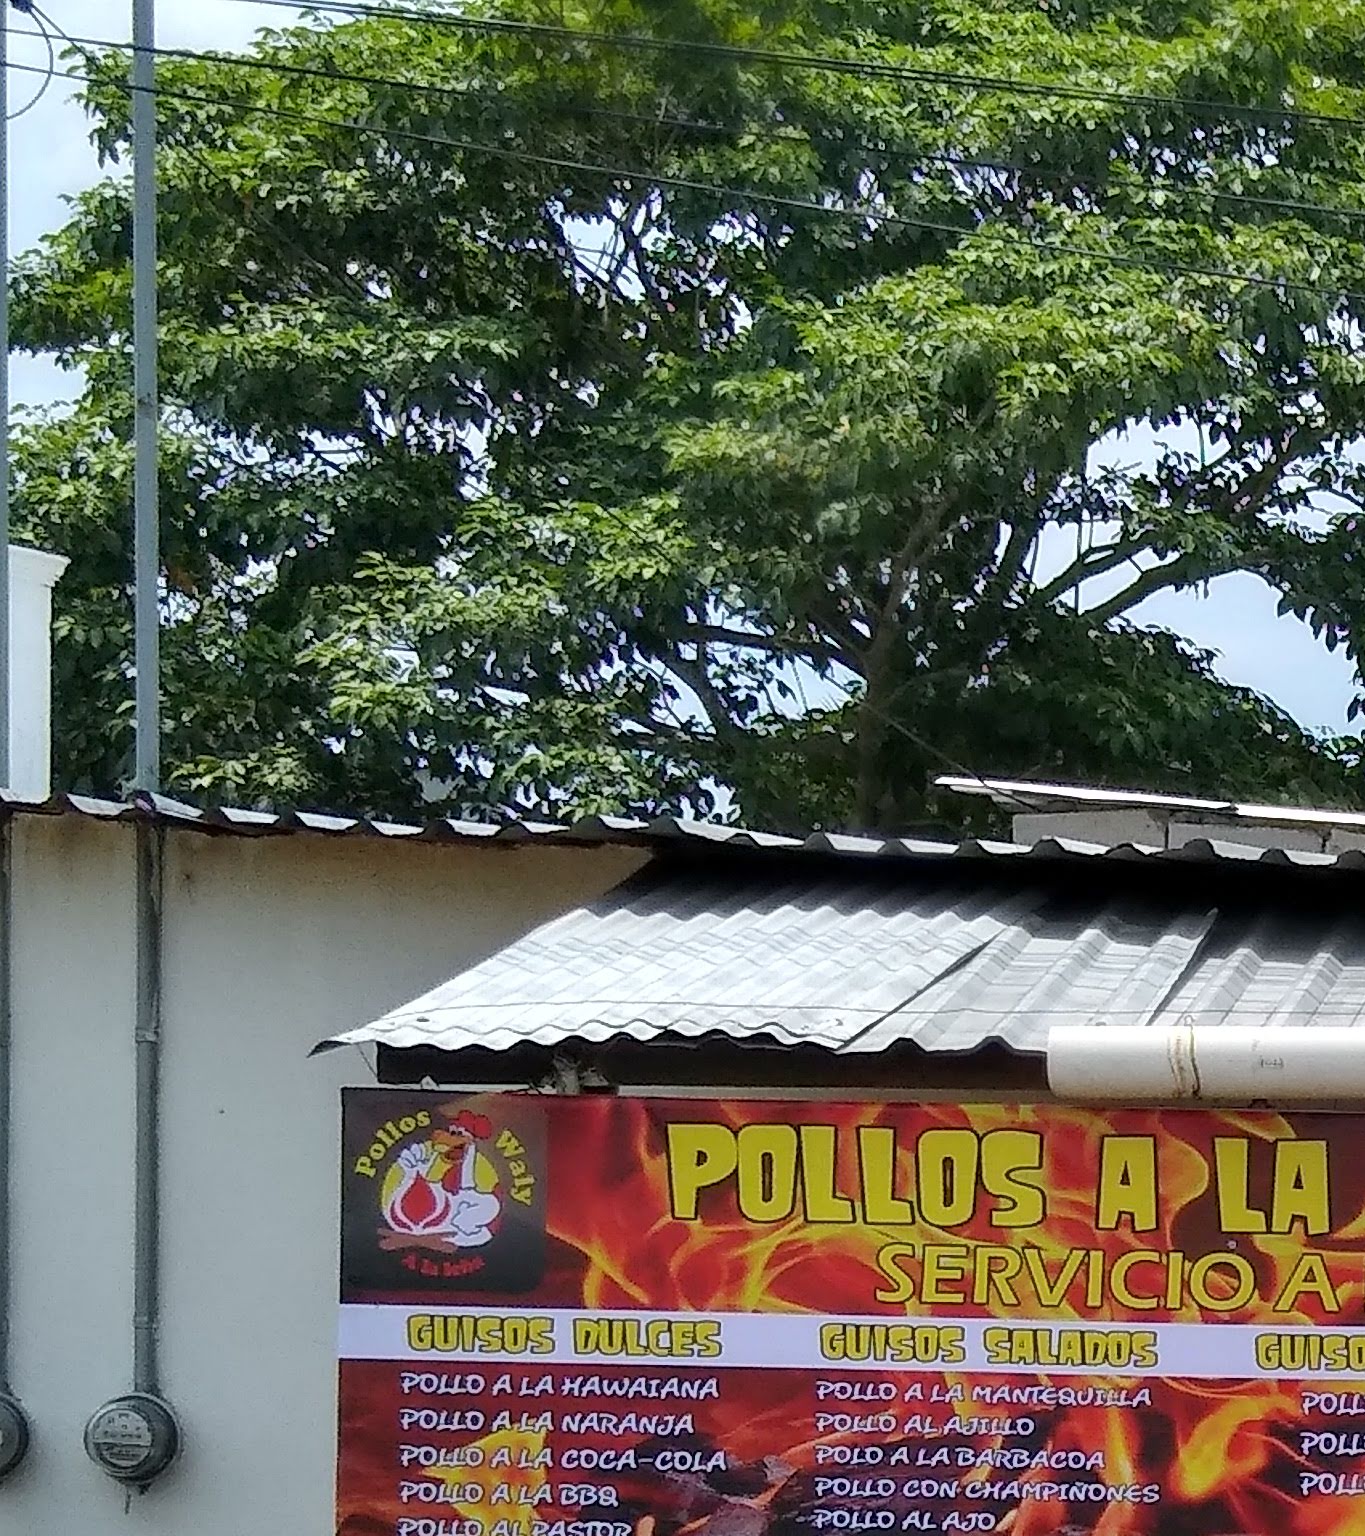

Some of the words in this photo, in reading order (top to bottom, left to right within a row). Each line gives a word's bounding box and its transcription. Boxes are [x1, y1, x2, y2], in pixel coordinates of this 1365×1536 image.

[354, 1109, 432, 1179] Pollos
[495, 1127, 537, 1207] Waly
[665, 1122, 1048, 1229] POLLOS
[1096, 1134, 1158, 1232] A
[1213, 1135, 1330, 1236] LA
[875, 1241, 1259, 1313] SERVICIO
[1273, 1252, 1342, 1314] A
[407, 1314, 555, 1354] GUISOS
[574, 1318, 723, 1358] DULCES
[820, 1323, 965, 1363] GUISOS
[983, 1327, 1158, 1367] SALADOS
[401, 1372, 485, 1394] POLLO
[492, 1374, 512, 1395] A
[518, 1376, 555, 1396] LA
[561, 1376, 720, 1400] HAWAIANA
[816, 1380, 898, 1400] POLLO
[904, 1382, 923, 1402] A
[929, 1383, 963, 1403] LA
[972, 1386, 1152, 1408] MANTEQUILLA
[400, 1408, 485, 1431] POLLO
[492, 1409, 512, 1431] A
[518, 1411, 553, 1432] LA
[561, 1412, 695, 1436] NARANJA
[815, 1413, 897, 1433] POLLO
[903, 1414, 938, 1434] AL
[943, 1415, 1035, 1436] AJILLO
[400, 1444, 483, 1468] POLLO
[490, 1446, 512, 1469] A
[517, 1447, 553, 1469] LA
[561, 1449, 727, 1472] COCA-COLA
[815, 1445, 884, 1465] POLO
[890, 1446, 910, 1465] A
[915, 1448, 951, 1467] LA
[954, 1448, 1105, 1470] BARBACOA
[399, 1481, 483, 1504] POLLO
[490, 1483, 512, 1504] A
[517, 1483, 552, 1505] LA
[560, 1484, 619, 1508] BBQ
[815, 1477, 895, 1498] POLLO
[903, 1479, 958, 1499] CON
[965, 1480, 1160, 1502] CHAMPIÑONES
[814, 1510, 895, 1530] POLLO
[901, 1511, 937, 1530] AL
[941, 1513, 997, 1532] AJO
